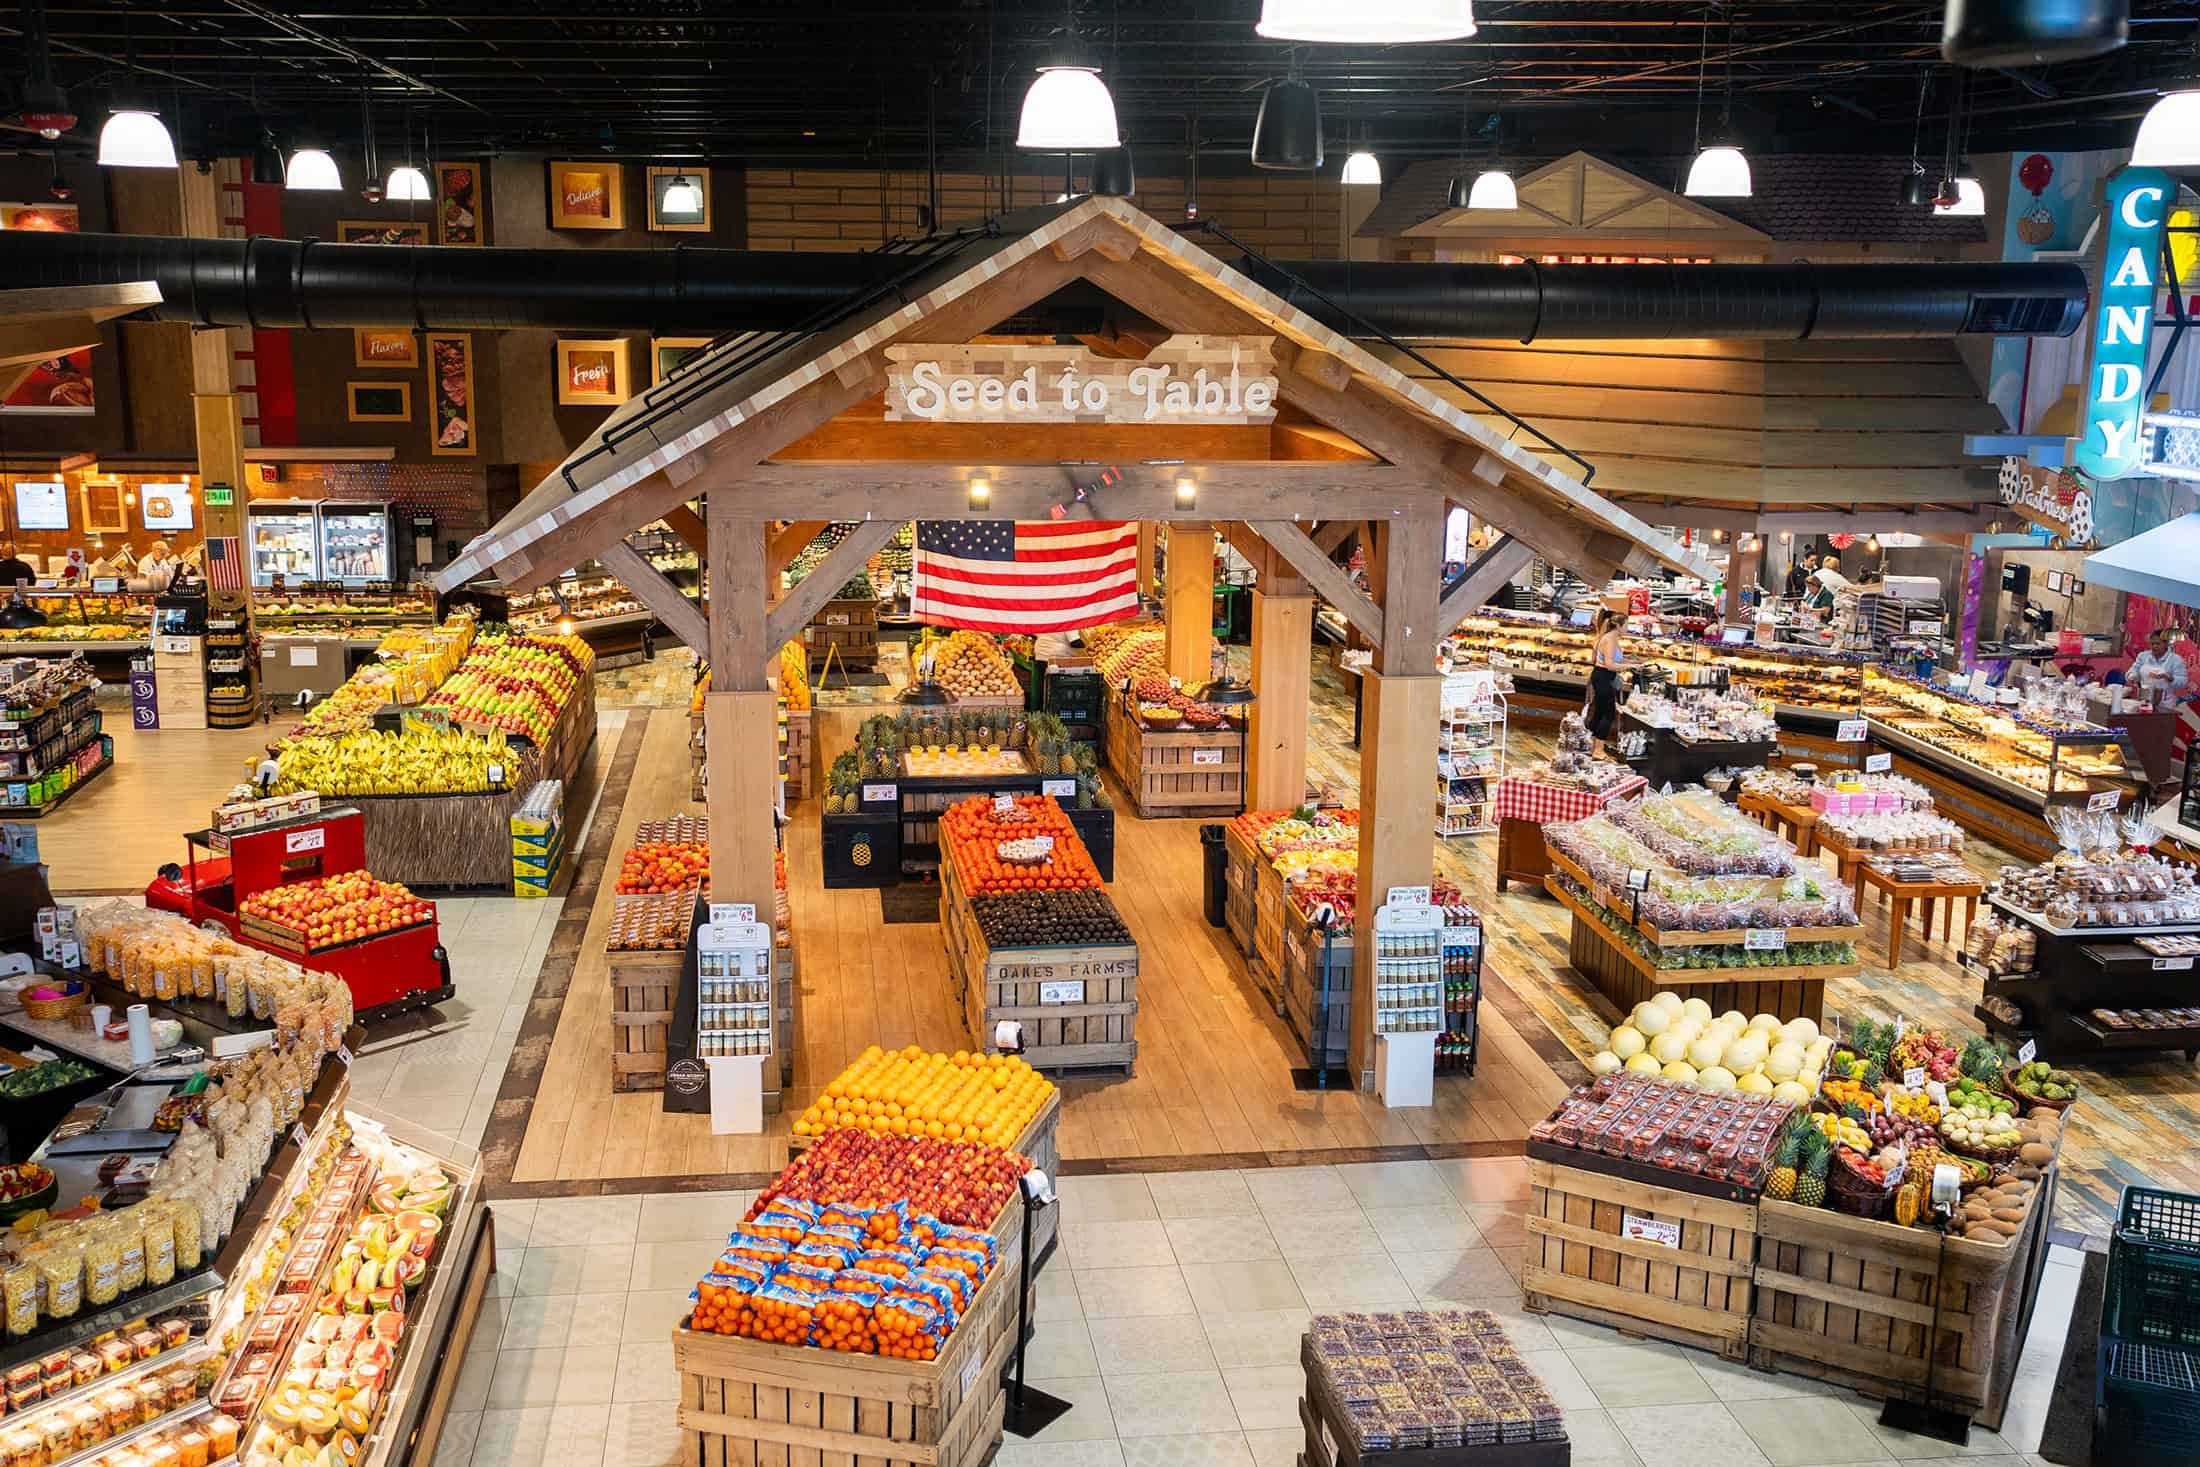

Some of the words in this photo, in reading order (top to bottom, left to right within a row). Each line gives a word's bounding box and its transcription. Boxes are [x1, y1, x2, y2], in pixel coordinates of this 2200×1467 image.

[2097, 187, 2163, 459] CANDY
[573, 360, 609, 385] Fresh
[904, 361, 1039, 418] Seed
[1061, 360, 1109, 411] to
[1128, 342, 1273, 419] Table
[2017, 475, 2068, 522] Pastries
[999, 966, 1054, 979] OAKES
[1070, 962, 1125, 977] FARMS
